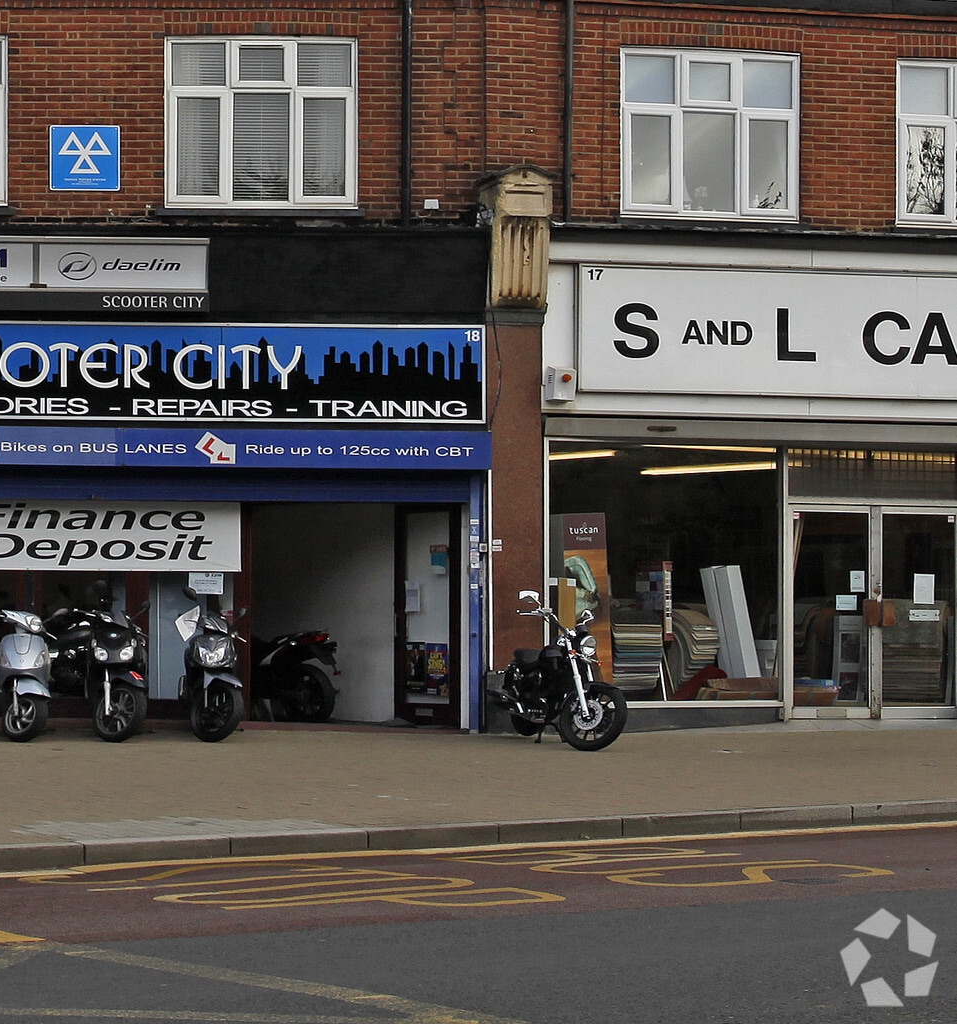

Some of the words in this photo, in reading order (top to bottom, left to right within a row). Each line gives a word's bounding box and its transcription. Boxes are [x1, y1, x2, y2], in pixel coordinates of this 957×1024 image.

[102, 258, 181, 271] daelim
[587, 269, 604, 281] 17
[102, 295, 168, 309] SCOOTER
[172, 296, 205, 309] CITY
[464, 330, 481, 342] 18
[612, 301, 661, 360] S
[680, 318, 754, 347] AND
[775, 307, 818, 363] L
[861, 309, 957, 366] CA
[173, 343, 302, 390] CITY
[132, 398, 273, 417] REPAIRS
[308, 400, 468, 417] TRAINING
[0, 442, 47, 453] Bikes
[52, 444, 74, 453] on
[80, 443, 119, 453] BUS
[124, 444, 187, 454] LANES
[245, 445, 285, 456] Ride
[290, 447, 311, 457] up
[317, 446, 334, 456] to
[340, 446, 391, 456] 125cc
[395, 446, 430, 457] with
[435, 447, 474, 457] CBT
[569, 526, 599, 535] tuscan
[432, 846, 895, 888] BUS
[16, 863, 566, 911] STOP
